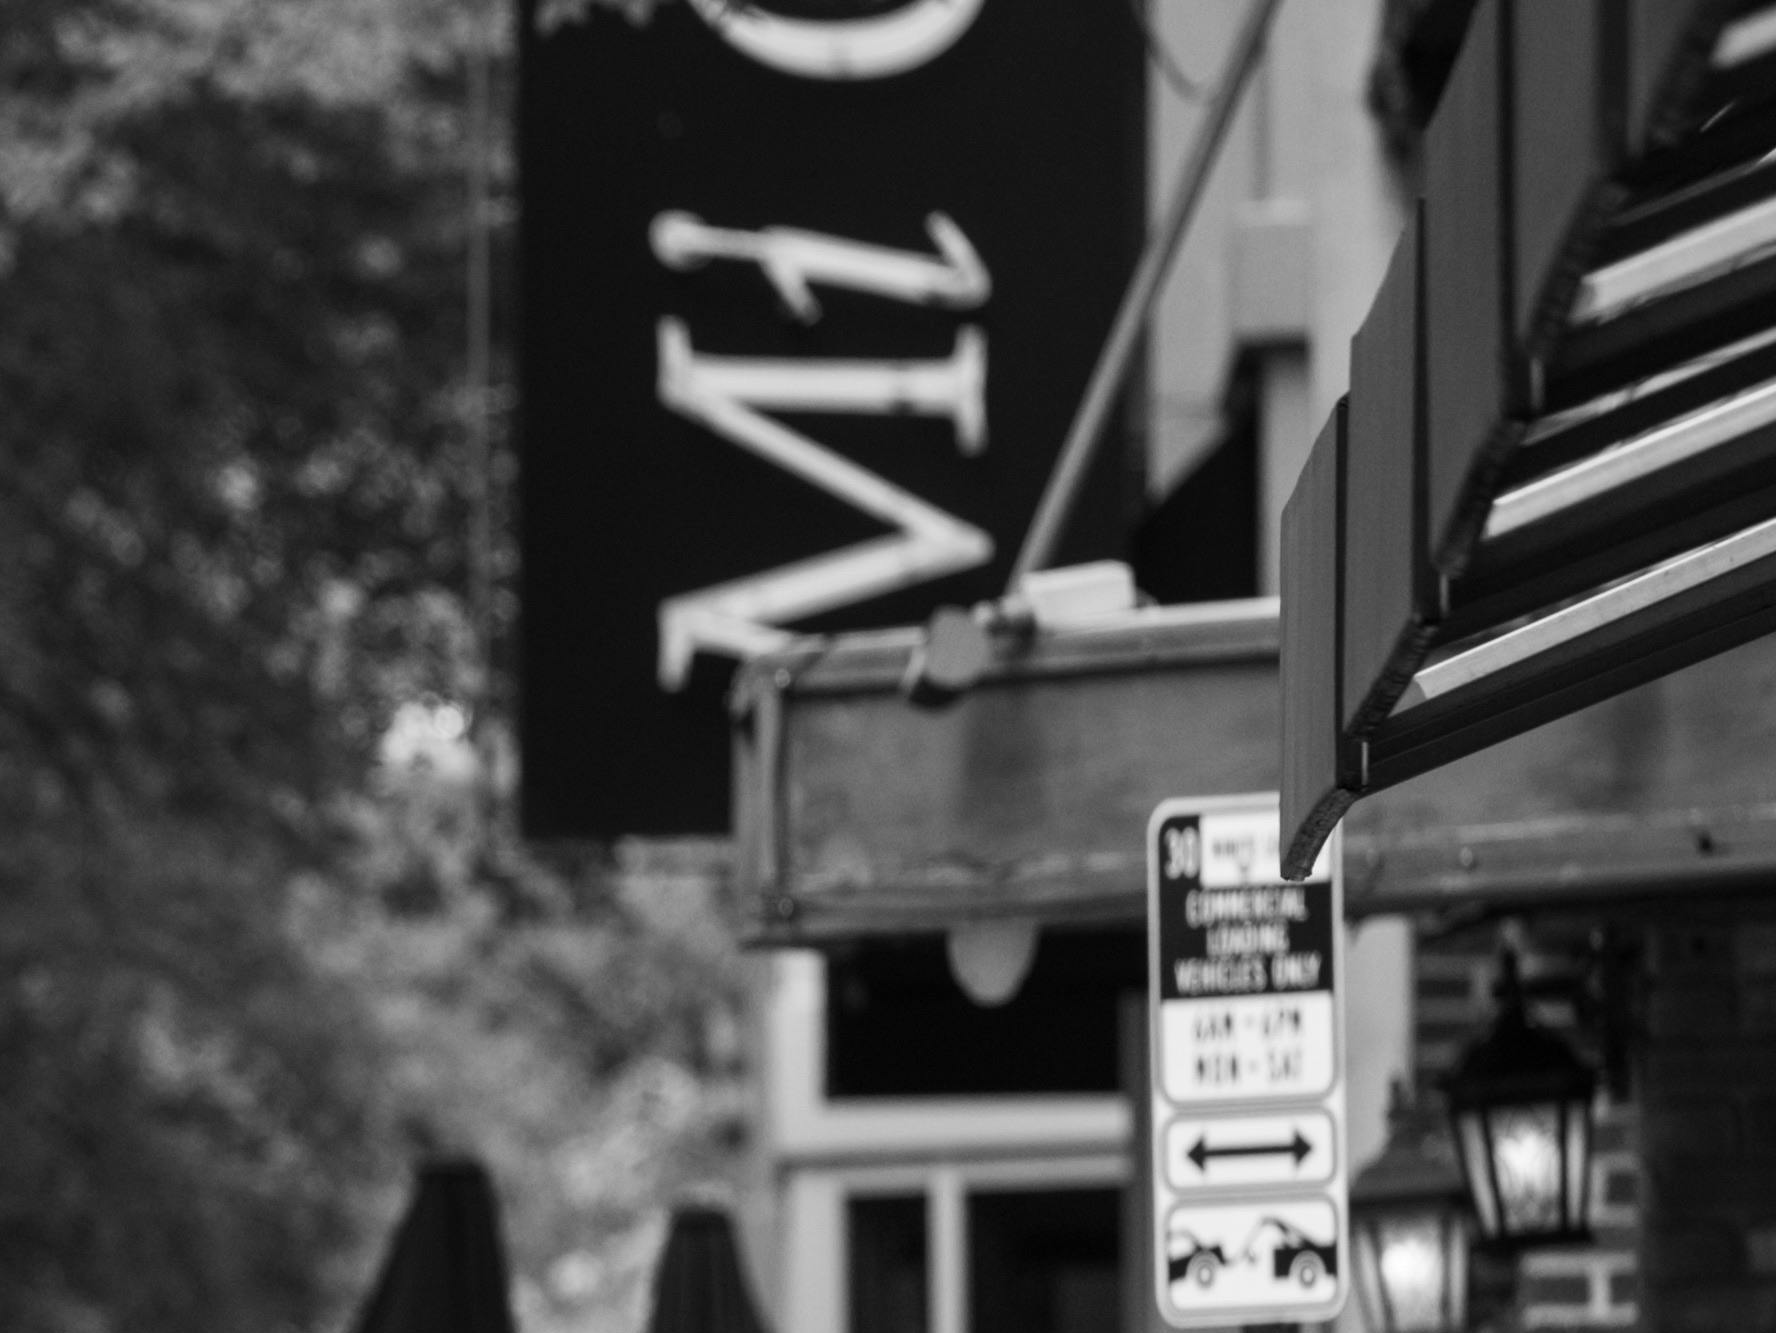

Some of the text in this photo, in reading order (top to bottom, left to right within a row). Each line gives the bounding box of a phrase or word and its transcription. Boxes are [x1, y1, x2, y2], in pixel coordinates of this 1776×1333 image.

[1185, 887, 1308, 929] COMMERCIAL
[1206, 922, 1291, 957] LOADING
[1174, 951, 1322, 995] VEHICLES ONLY
